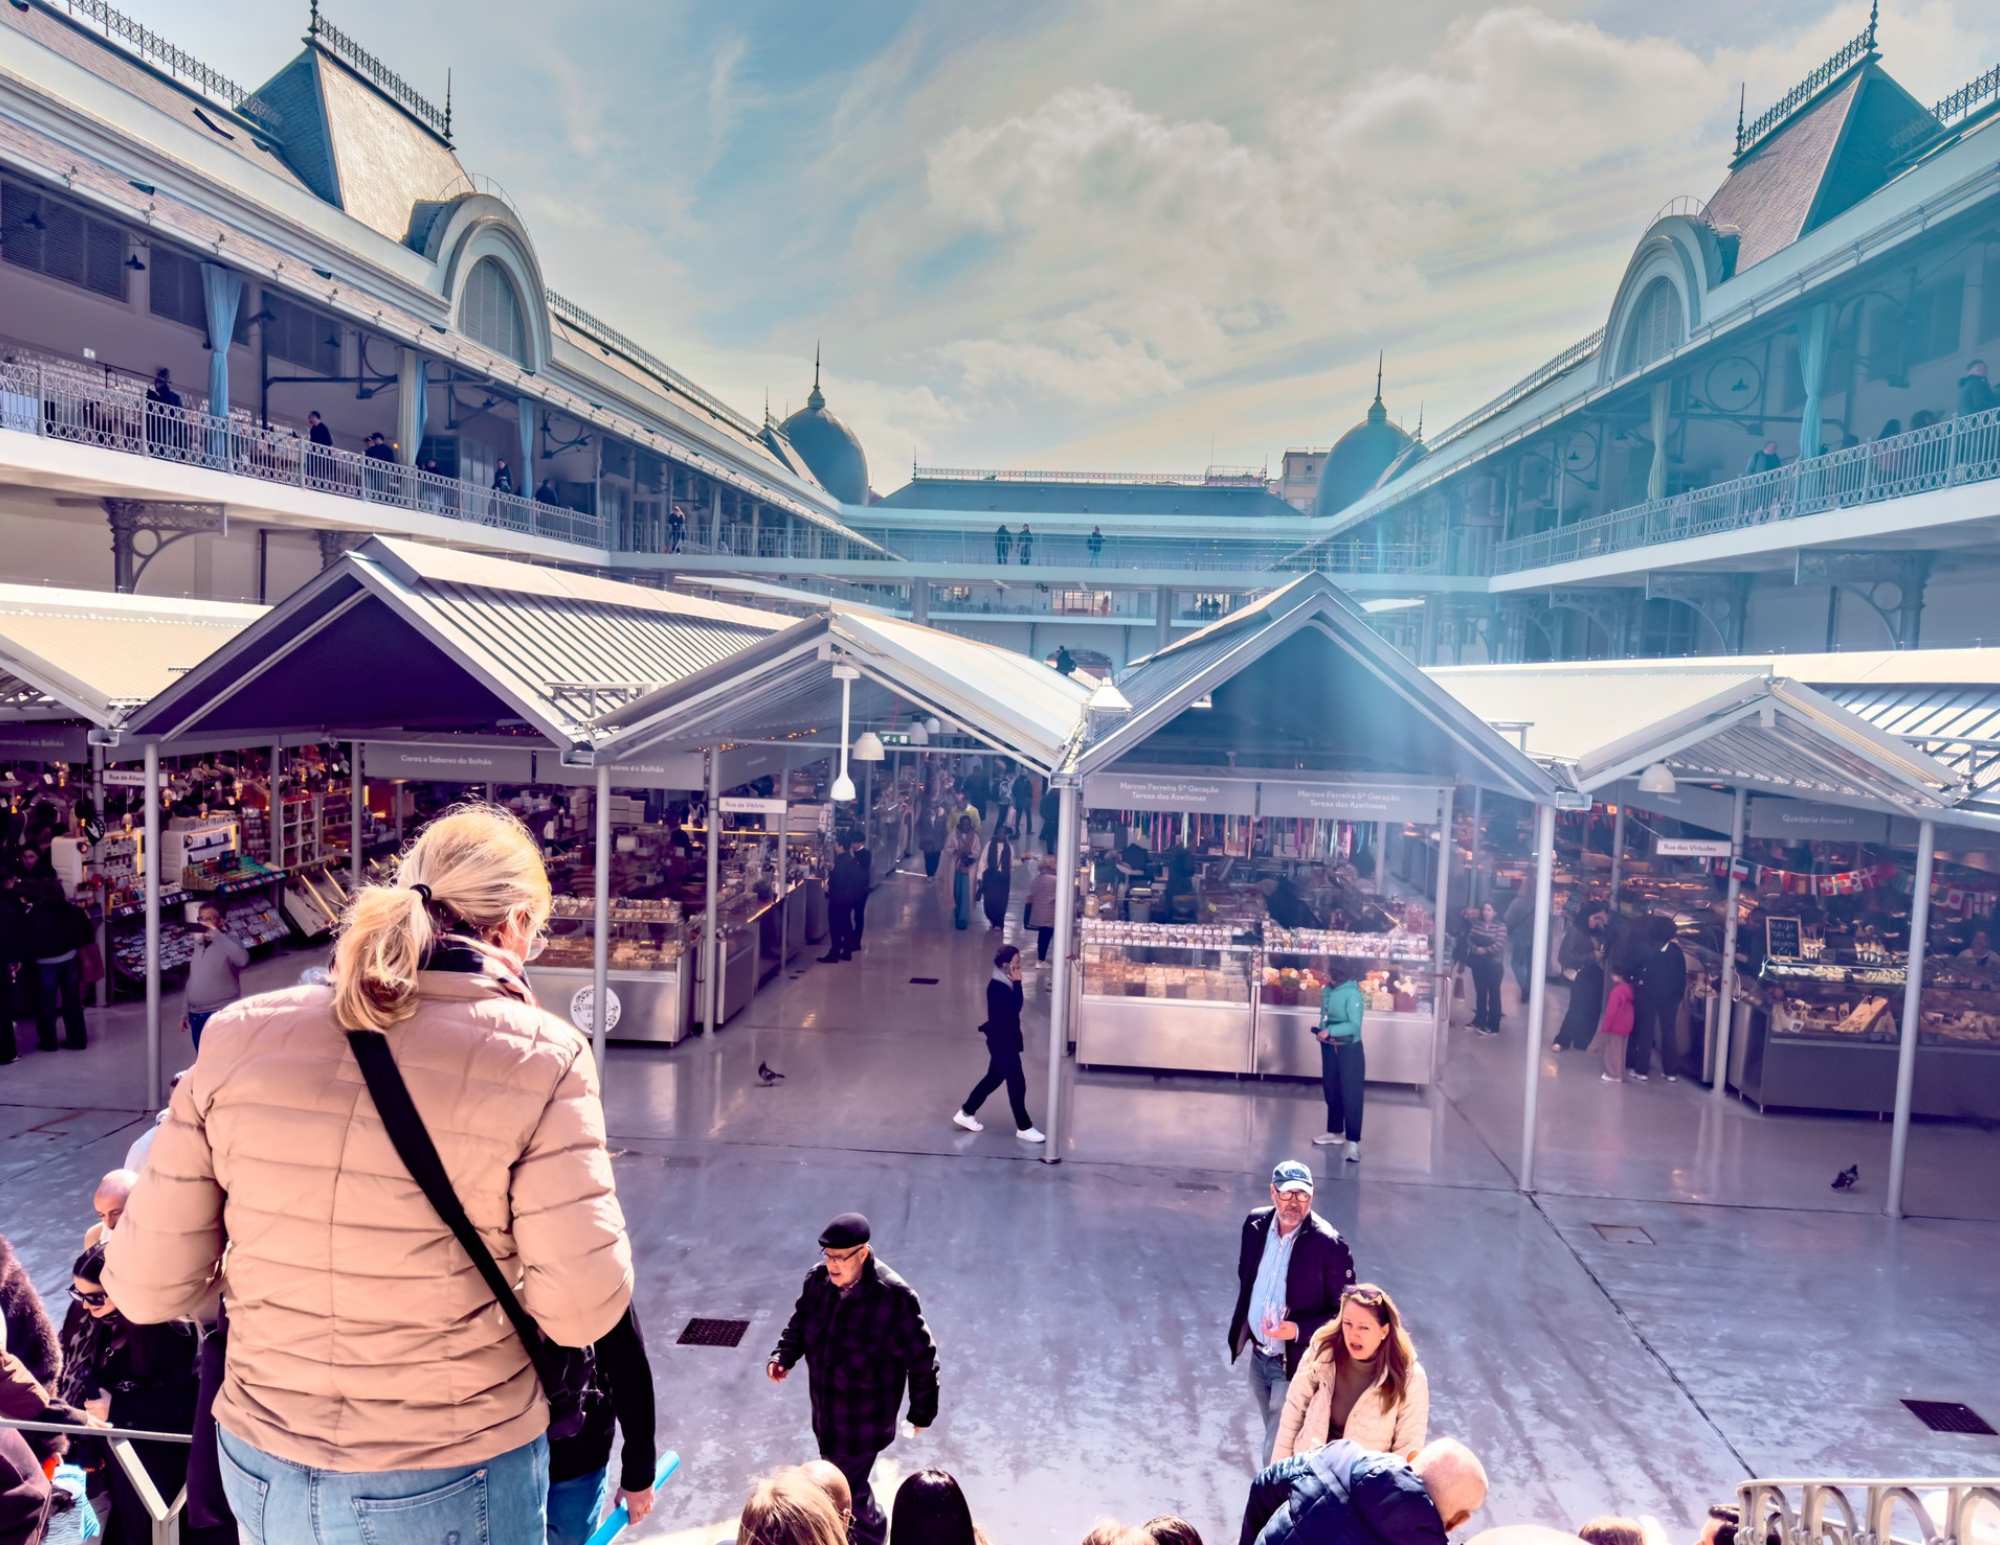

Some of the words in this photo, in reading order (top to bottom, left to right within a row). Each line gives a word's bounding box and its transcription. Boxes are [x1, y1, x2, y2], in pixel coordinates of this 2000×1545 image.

[428, 756, 457, 764] Sabores
[468, 757, 492, 765] Bolhão
[1120, 782, 1147, 790] Marcos
[1148, 783, 1177, 791] Ferreira
[1187, 785, 1220, 794] Geração
[1132, 791, 1155, 799] Teresa
[1156, 792, 1170, 800] das
[1170, 793, 1207, 801] Azeitonas
[1297, 790, 1325, 798] Marcos
[1326, 791, 1357, 800] Ferreira
[1367, 793, 1400, 802] Geração
[1310, 799, 1334, 807] Teresa
[1335, 800, 1348, 808] das
[1349, 801, 1387, 810] Azeitonas
